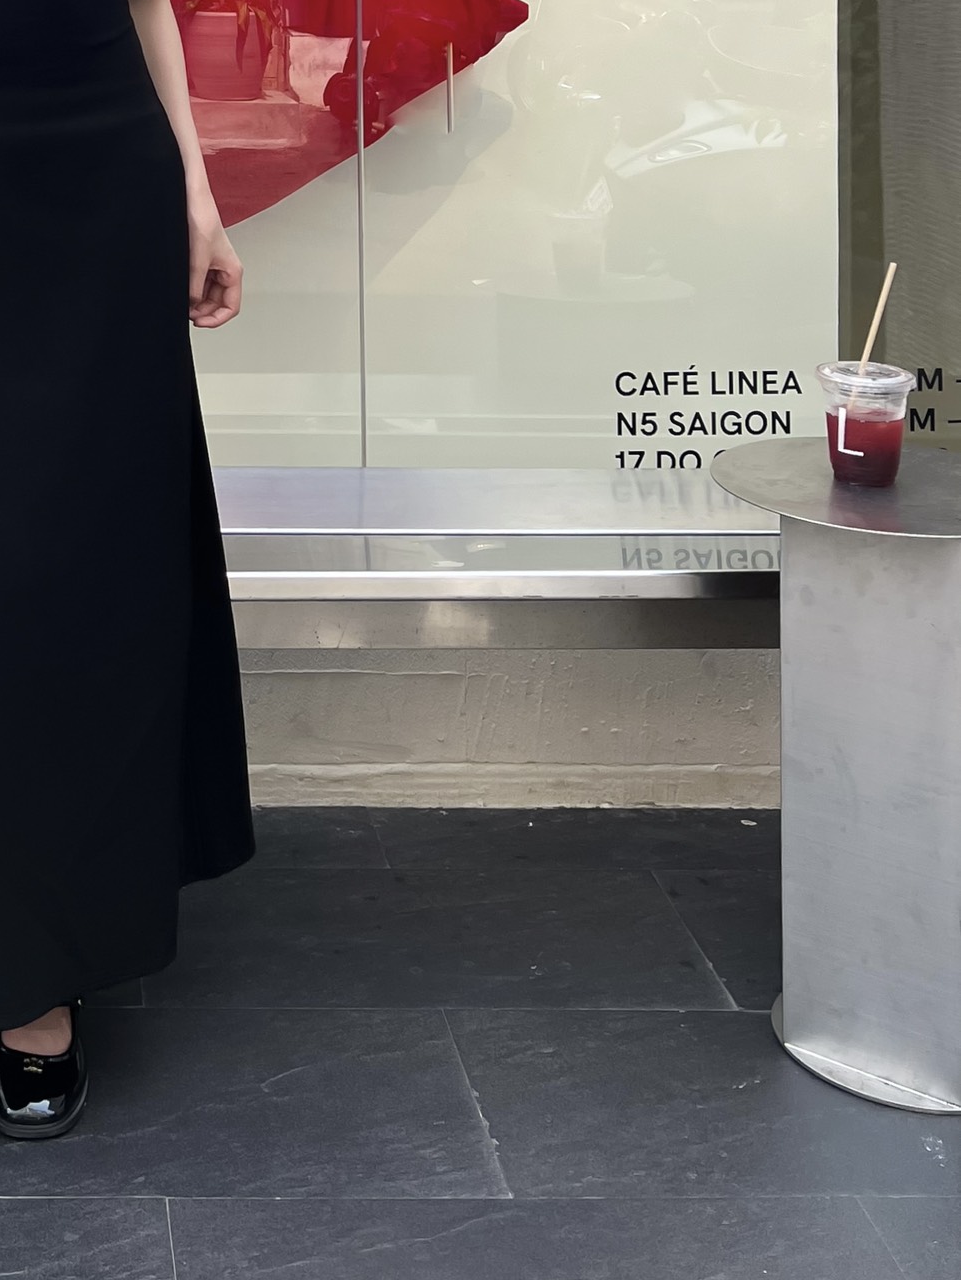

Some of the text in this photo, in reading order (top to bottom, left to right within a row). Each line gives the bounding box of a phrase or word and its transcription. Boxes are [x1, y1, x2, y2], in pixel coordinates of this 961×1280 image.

[615, 365, 700, 396] CAFÉ
[711, 370, 803, 395] LINEA
[617, 412, 658, 436] N5
[668, 410, 791, 436] SAIGON
